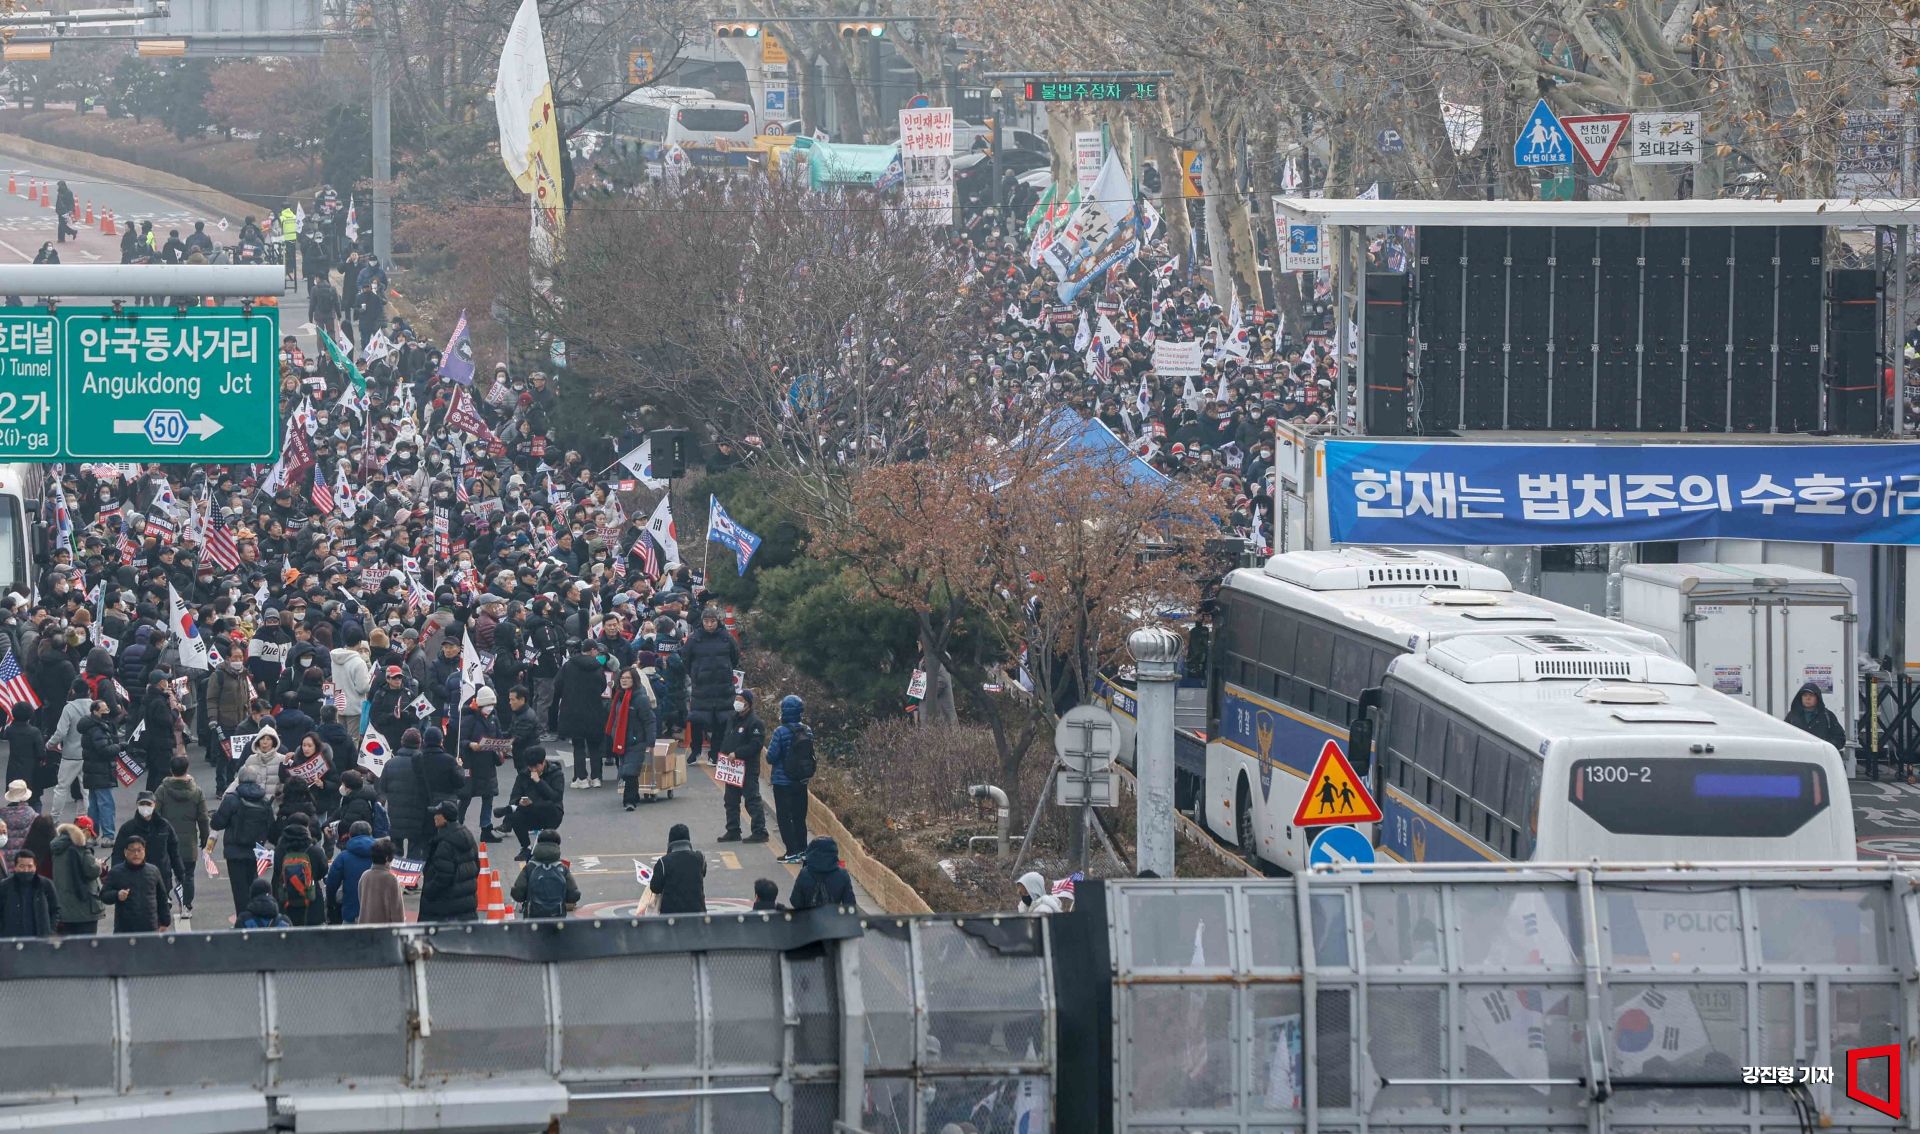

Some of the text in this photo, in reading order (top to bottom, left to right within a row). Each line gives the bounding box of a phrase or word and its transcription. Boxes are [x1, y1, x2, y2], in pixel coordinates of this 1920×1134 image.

[1042, 83, 1121, 100] 불법주정차
[904, 112, 951, 131] 인민재판!!
[1580, 124, 1610, 136] 천천히
[768, 127, 781, 136] 30
[905, 132, 951, 151] 무법천지!!
[1584, 136, 1607, 145] SLOW
[1638, 141, 1694, 157] 절대감속
[1523, 153, 1567, 163] 어린이보호
[80, 326, 258, 364] 안국동사거리
[10, 358, 51, 377] Tunnel
[82, 371, 252, 400] Angukdong Jct
[154, 416, 179, 438] 50
[1352, 468, 1504, 520] 헌재는
[1519, 472, 1732, 521] 법치주의
[293, 758, 319, 775] STOP
[721, 757, 741, 768] STOP
[717, 771, 741, 784] STEAL
[1585, 766, 1651, 782] 1300-2
